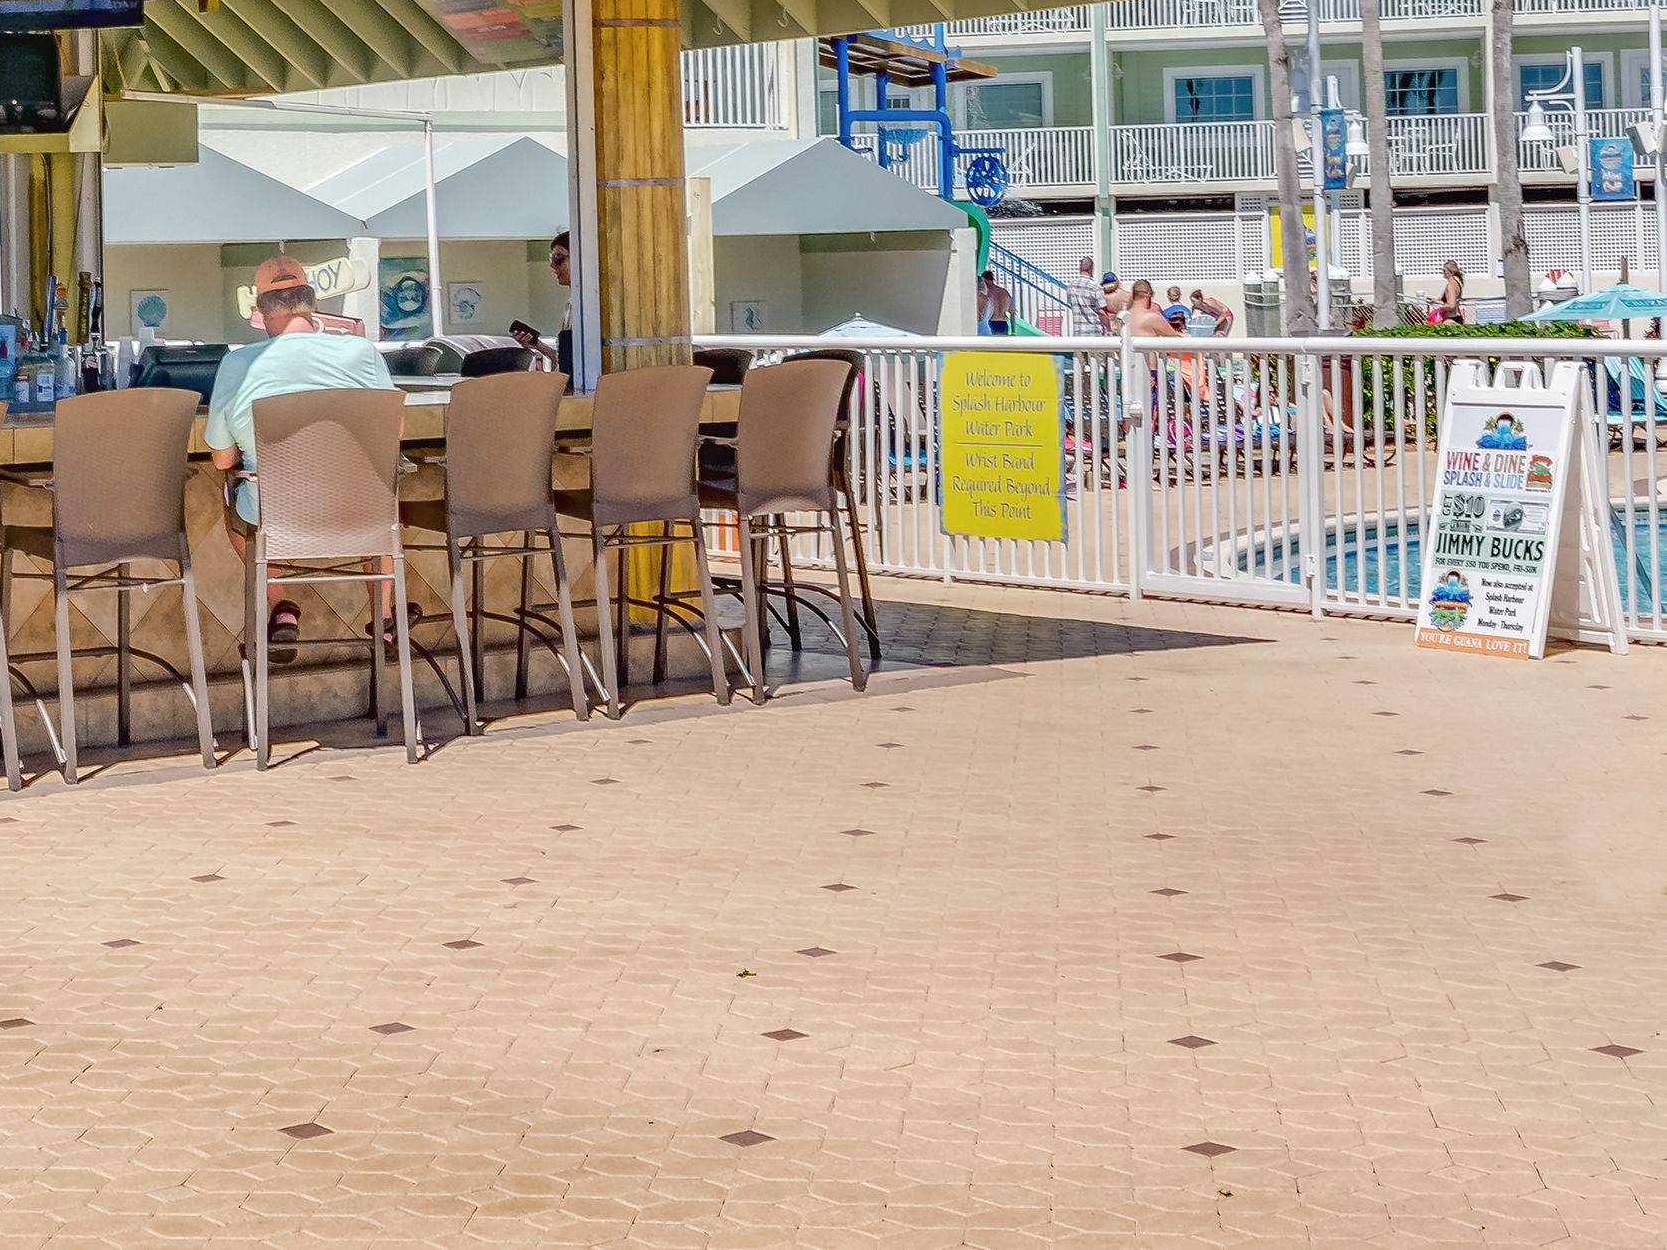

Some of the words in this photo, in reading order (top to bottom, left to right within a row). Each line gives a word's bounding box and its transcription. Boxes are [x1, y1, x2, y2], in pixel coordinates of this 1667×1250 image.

[965, 368, 1016, 388] Welcome
[1019, 373, 1032, 386] to
[952, 395, 992, 416] Splash
[996, 397, 1047, 413] Harbour
[965, 421, 1000, 437] Water
[1005, 421, 1034, 438] Park
[965, 452, 998, 469] Wrist
[1003, 452, 1034, 470] Band
[1446, 451, 1481, 471] WINE
[1482, 453, 1491, 472] &
[1494, 454, 1527, 474] DINE
[952, 475, 1003, 498] Required
[1006, 477, 1051, 503] Beyond
[1443, 470, 1483, 488] SPLASH
[1484, 473, 1491, 488] &
[1494, 473, 1524, 490] SLIDE
[973, 500, 997, 518] This
[1001, 502, 1032, 520] Point
[1442, 494, 1453, 516] GET
[1453, 494, 1485, 519] $10
[1435, 533, 1486, 557] JIMMY
[1490, 537, 1545, 562] BUCKS
[1435, 557, 1446, 566] FOR
[1447, 558, 1464, 567] EVERY
[1478, 561, 1489, 570] YOU
[1481, 578, 1492, 588] Now
[1493, 580, 1503, 589] also
[1504, 582, 1527, 592] accepted
[1485, 592, 1502, 604] Splash
[1489, 606, 1505, 615] Water
[1505, 608, 1516, 617] Park
[1477, 618, 1497, 631] Monday
[1501, 621, 1524, 634] Thursday
[1420, 632, 1453, 645] YOU'RE
[1454, 635, 1483, 649] GUANA
[1485, 638, 1511, 652] LOVE
[1513, 642, 1528, 654] IT!
